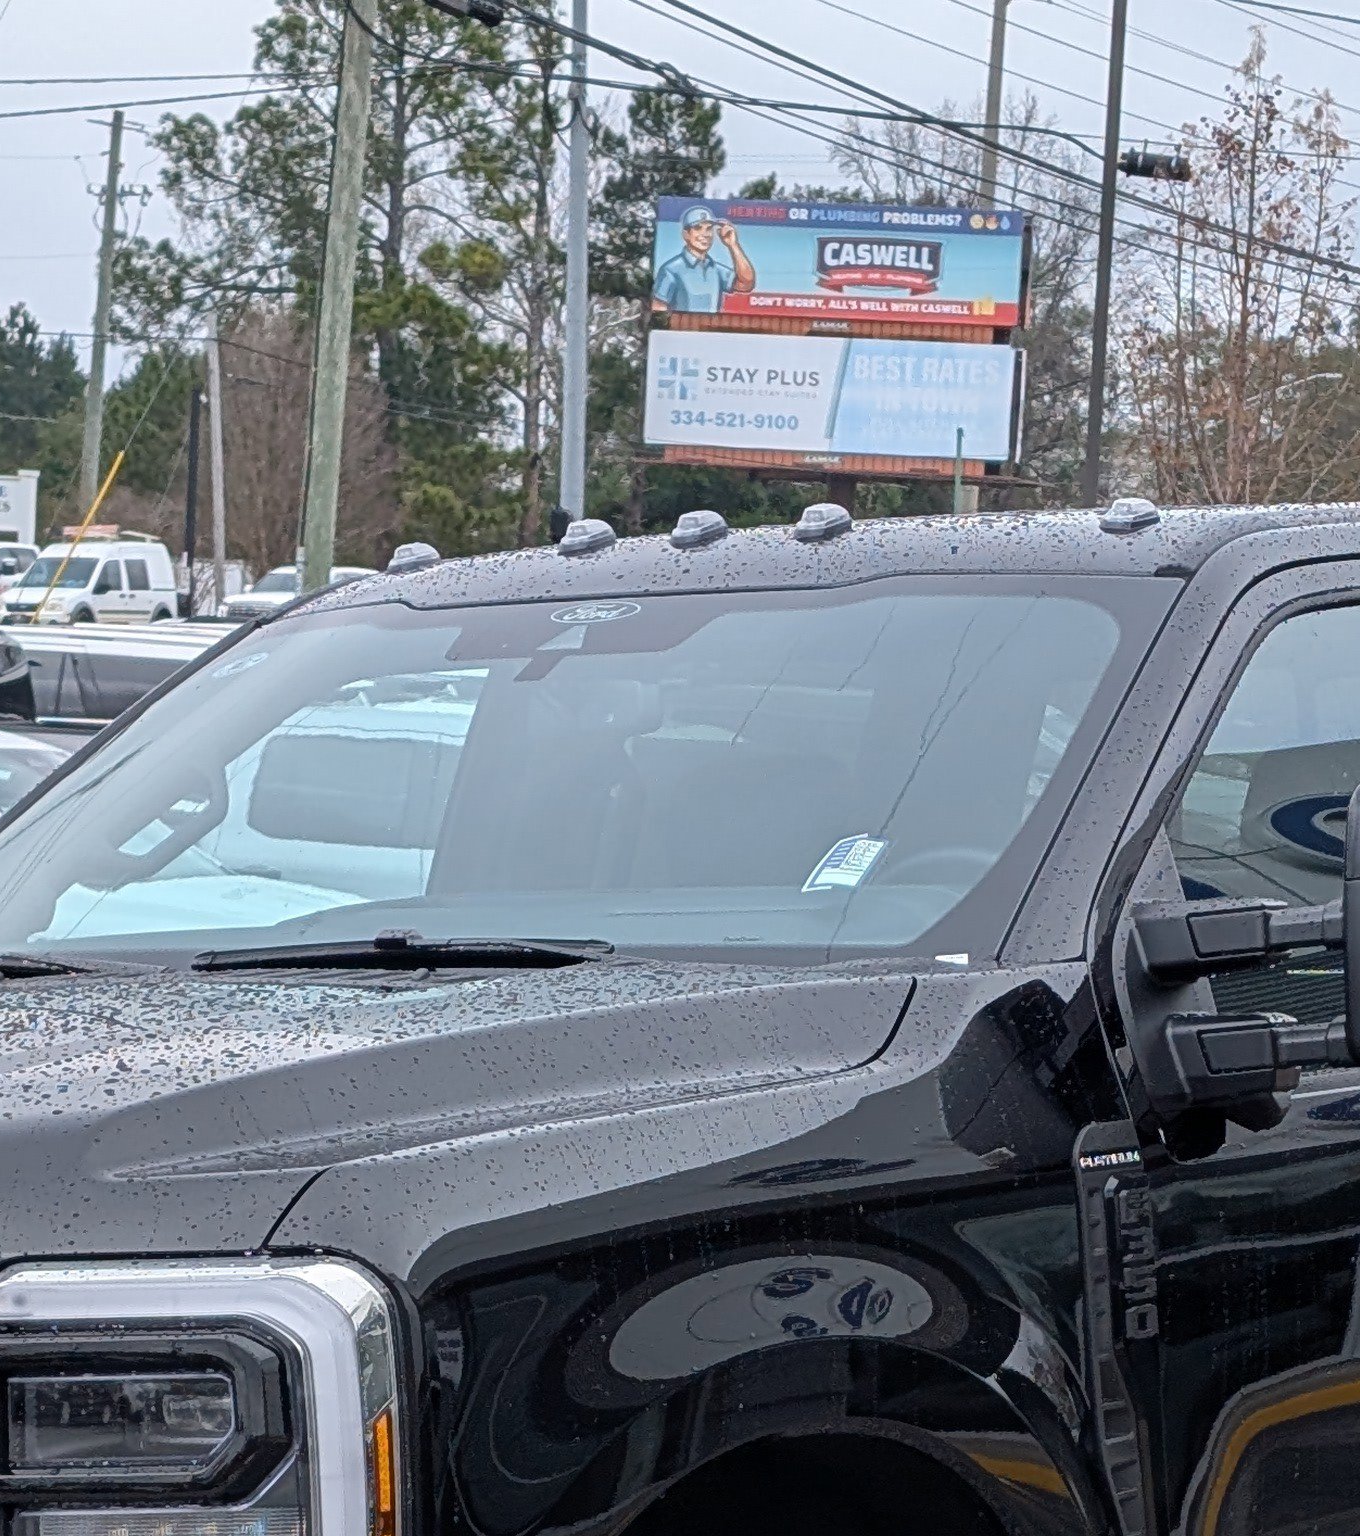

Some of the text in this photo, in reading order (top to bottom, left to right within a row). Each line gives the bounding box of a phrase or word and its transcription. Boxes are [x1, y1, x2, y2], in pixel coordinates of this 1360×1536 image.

[788, 208, 809, 220] OR
[811, 209, 880, 222] PLUMBING
[882, 211, 962, 226] PROBLEMS?
[824, 242, 934, 271] CASWELL
[749, 296, 971, 315] DON'T WORRY, ALL'S WELL WITH CASWELL
[706, 366, 820, 387] STAY PLUS
[854, 354, 1001, 384] BEST RATES
[671, 409, 799, 430] 334-521-9100
